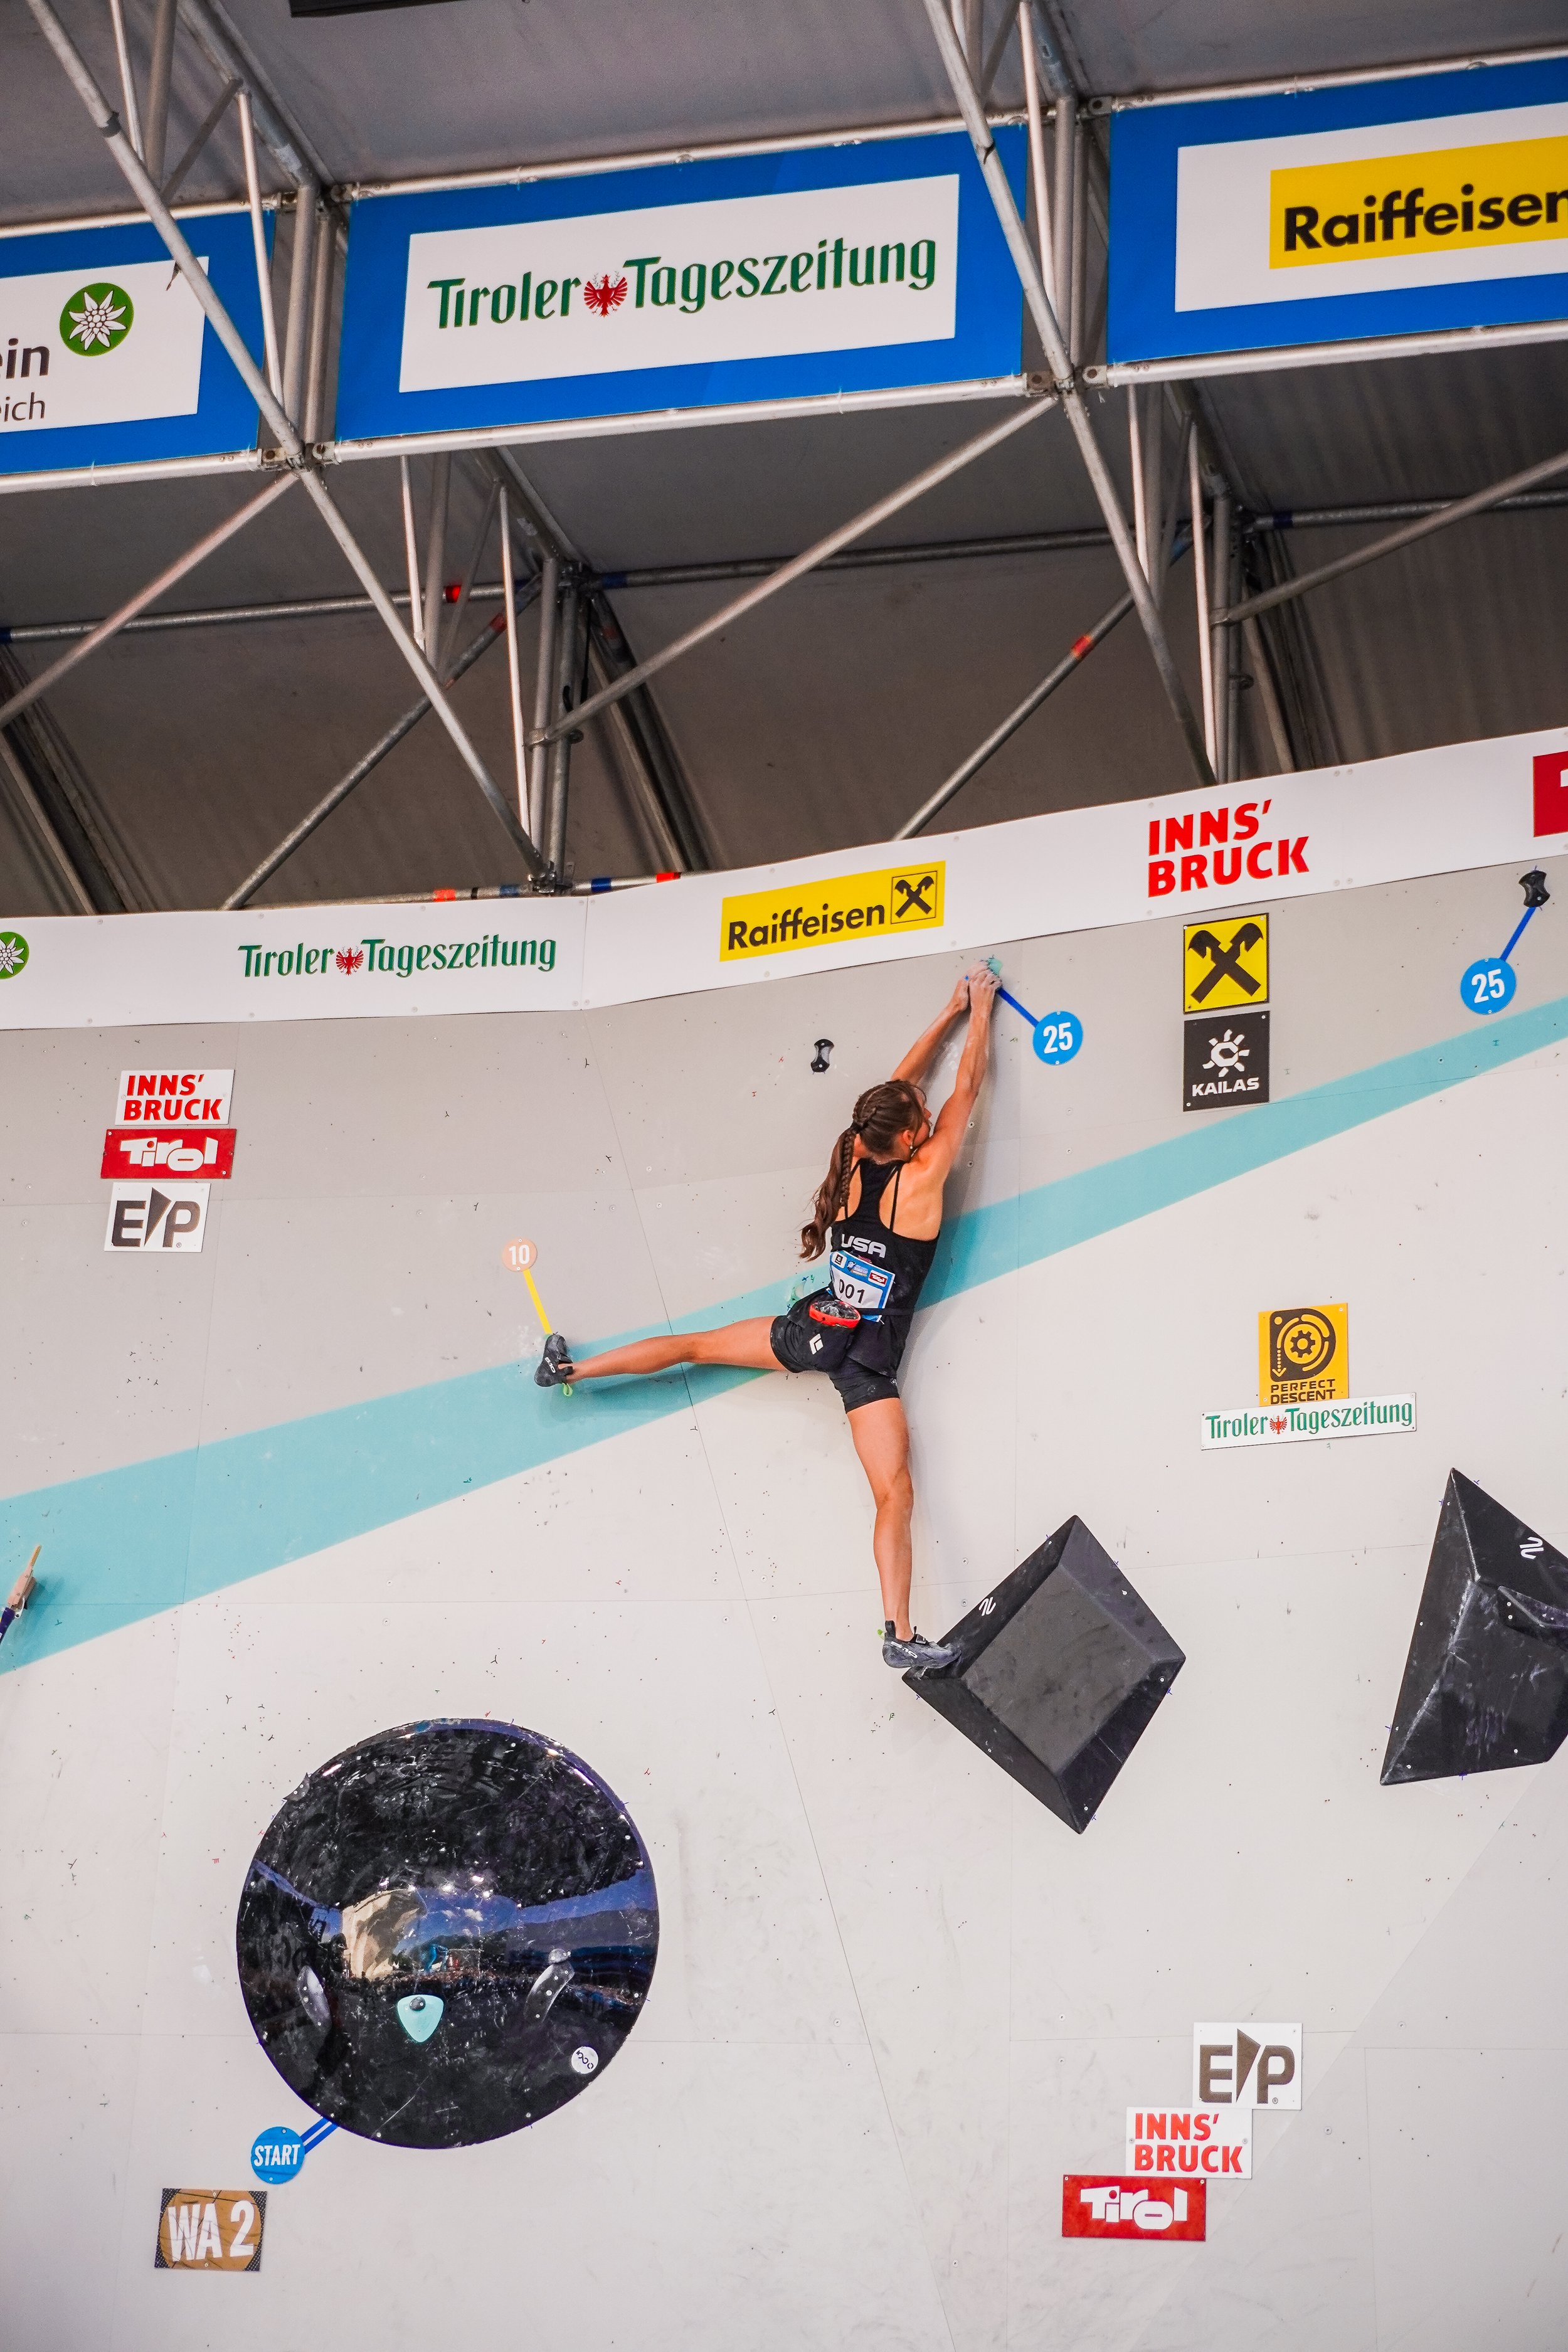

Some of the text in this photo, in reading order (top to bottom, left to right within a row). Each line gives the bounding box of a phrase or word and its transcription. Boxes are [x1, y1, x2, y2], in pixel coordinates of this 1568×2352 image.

[1283, 183, 1568, 252] Raiffeisen
[428, 238, 936, 329] Tiroler Tageszeitung
[0, 337, 50, 379] in
[0, 391, 46, 422] ich
[1148, 836, 1310, 898] BRUCK
[728, 903, 885, 951] Raiffeisen
[238, 934, 557, 978] Tiroler Tageszeitung
[1471, 968, 1505, 1005] 25
[1042, 1022, 1074, 1055] 25
[1192, 1076, 1259, 1097] KAILAS
[124, 1098, 223, 1121] BRUCK
[120, 1136, 219, 1172] Tirol
[509, 1244, 530, 1265] 10
[841, 1234, 886, 1258] USA
[1271, 1379, 1336, 1394] PERFECT
[1271, 1388, 1336, 1405] DESCENT
[1205, 1401, 1412, 1439] Tiroler Tageszeitung
[253, 2144, 301, 2167] START
[1134, 2144, 1243, 2173] BRUCK
[1080, 2185, 1188, 2230] Tirol
[167, 2200, 255, 2262] WA 2
